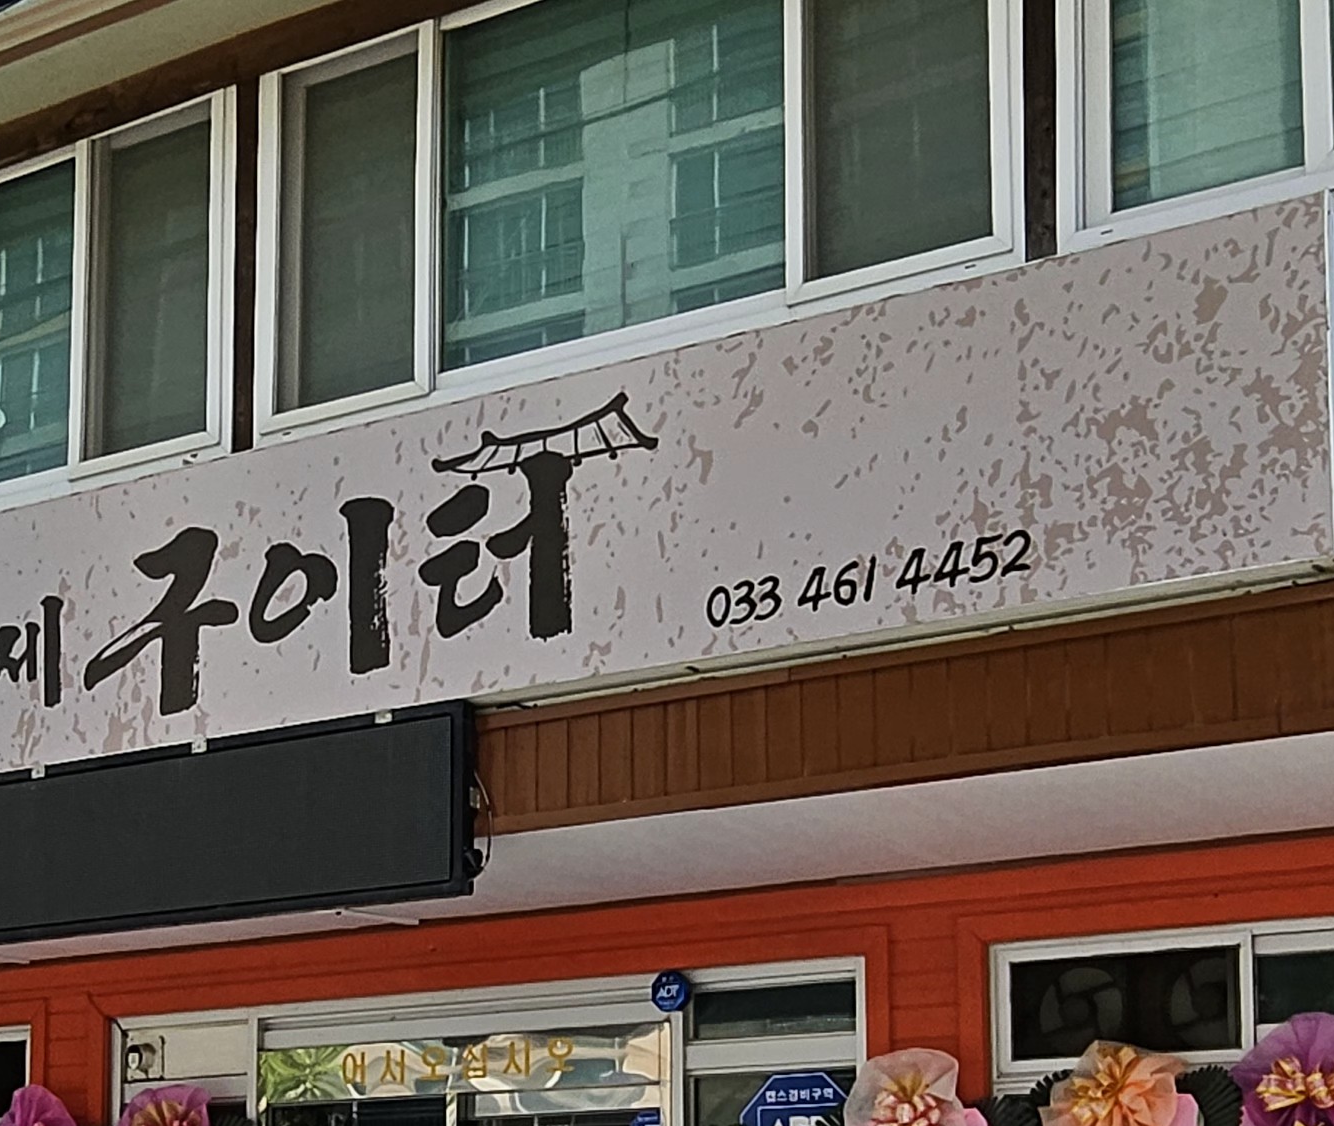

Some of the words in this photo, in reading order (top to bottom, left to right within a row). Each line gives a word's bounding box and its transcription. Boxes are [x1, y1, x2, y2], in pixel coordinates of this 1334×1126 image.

[84, 451, 573, 716] 구이터
[706, 576, 782, 628] 033
[797, 555, 877, 612] 461
[895, 529, 1033, 594] 4452
[656, 985, 679, 998] ADT
[341, 1035, 574, 1085] 어서오십시오
